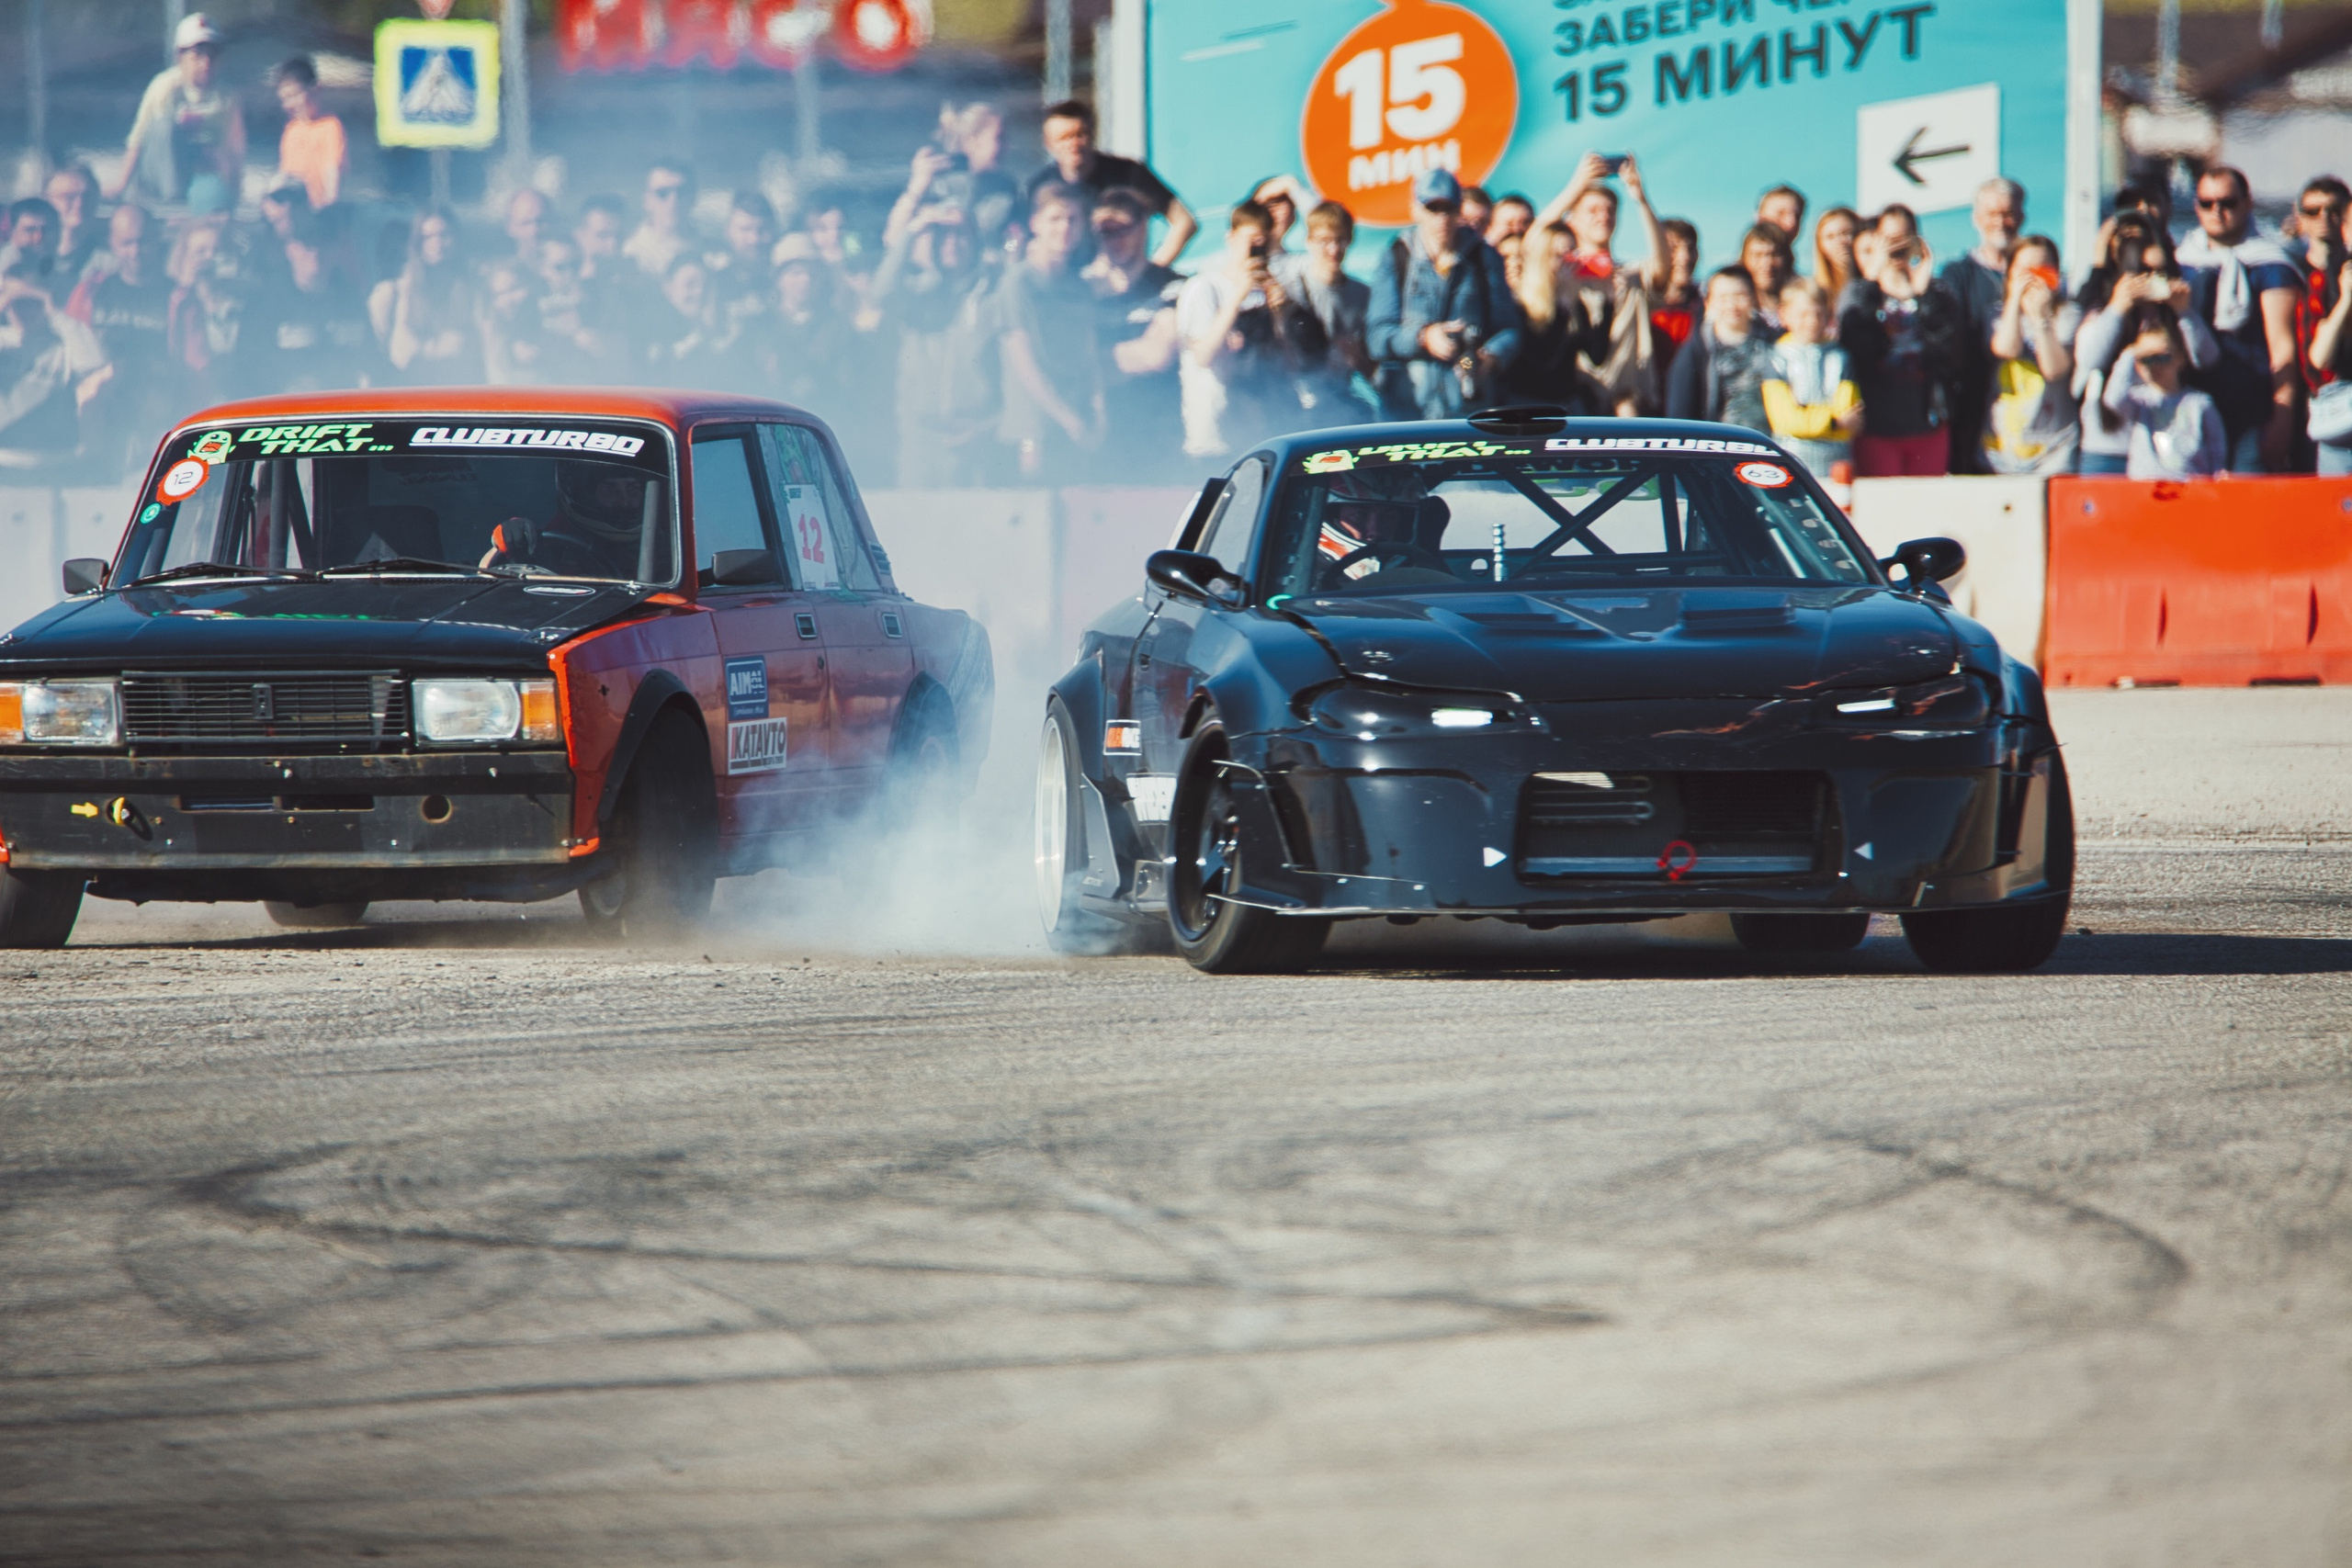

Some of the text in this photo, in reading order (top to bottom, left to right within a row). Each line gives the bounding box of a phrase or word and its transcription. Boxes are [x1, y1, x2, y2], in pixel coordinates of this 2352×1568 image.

[1554, 0, 1755, 56] ЗАБЕРИ
[1555, 4, 1938, 122] 15 МИНУТ
[1334, 31, 1467, 151] 15
[1348, 138, 1461, 192] МИН
[238, 423, 373, 443] DRIFT
[260, 437, 394, 455] THAT...
[410, 427, 645, 457] CLUBTURBO
[174, 471, 194, 485] 12
[1747, 469, 1780, 479] 63
[797, 513, 825, 564] 12
